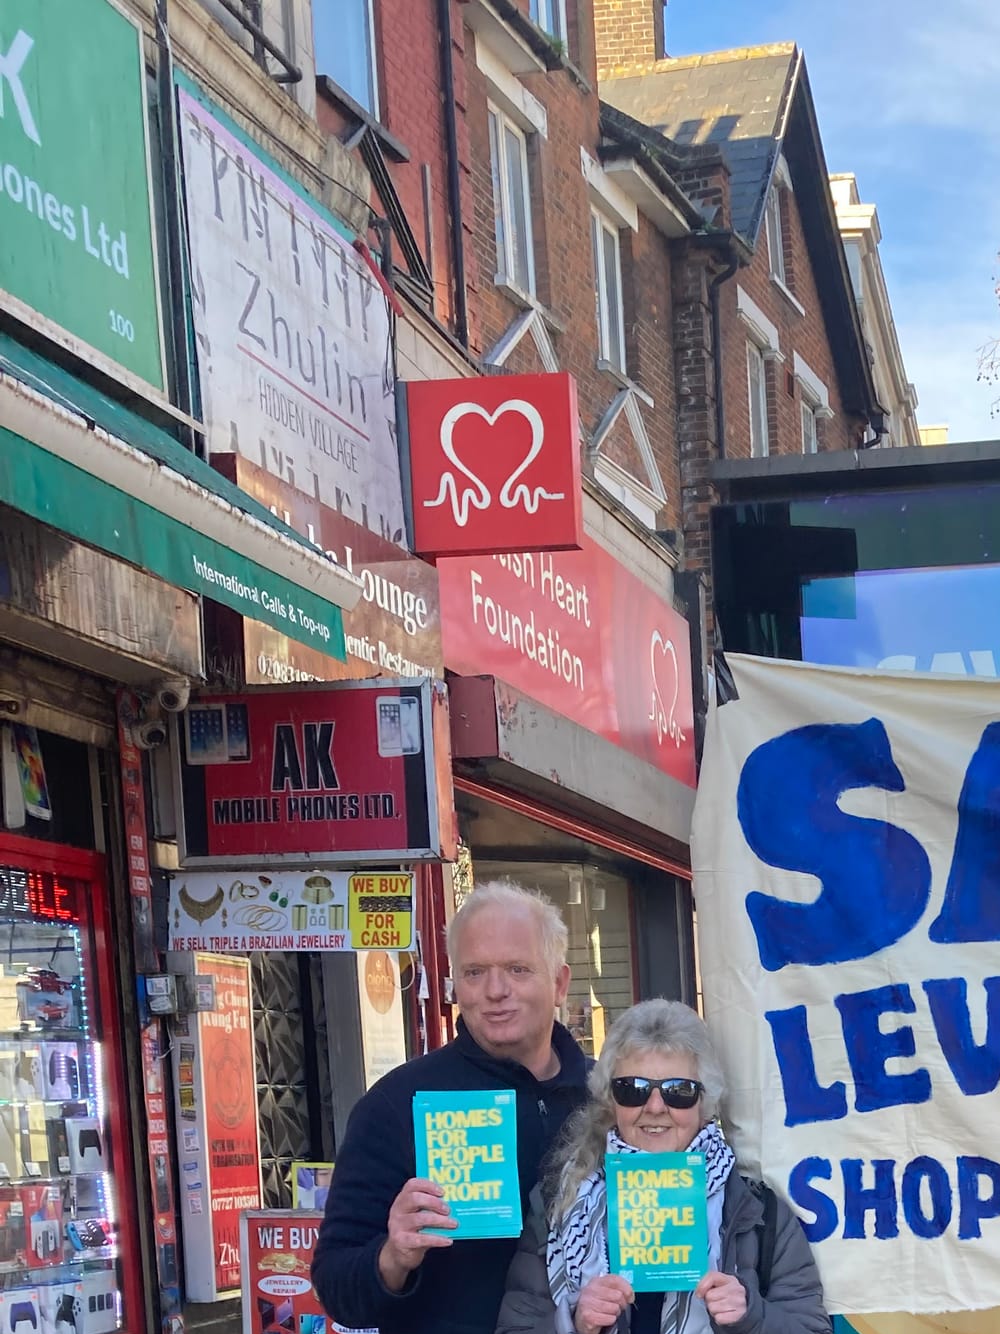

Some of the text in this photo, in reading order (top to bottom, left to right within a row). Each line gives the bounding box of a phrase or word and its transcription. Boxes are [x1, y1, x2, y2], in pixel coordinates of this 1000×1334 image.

[0, 161, 129, 280] ones Ltd
[108, 308, 135, 343] 100
[234, 258, 367, 424] Zhulin
[257, 375, 360, 474] HIDDEN VILLAGE
[192, 554, 331, 643] International Calls & Top-up
[540, 551, 591, 629] Heart
[470, 569, 585, 692] Foundation
[343, 632, 377, 664] entic
[270, 720, 340, 793] AK
[212, 798, 281, 826] MOBILE
[286, 793, 360, 823] PHONES
[352, 877, 410, 894] WE BUY
[365, 913, 395, 930] FOR
[172, 933, 346, 951] WE SELL TRIPLE A BRAZILIAN JEWELLERY
[360, 930, 401, 947] CASH
[425, 1109, 503, 1130] HOMES
[426, 1129, 467, 1148] FOR
[427, 1144, 505, 1167] PEOPLE
[428, 1164, 473, 1184] NOT
[616, 1169, 694, 1190] HOMES
[440, 1180, 503, 1202] ROFIT
[617, 1189, 659, 1208] FOR
[618, 1206, 695, 1228] PEOPLE
[257, 1227, 284, 1249] WE
[619, 1226, 665, 1247] NOT
[620, 1245, 693, 1266] PROFIT
